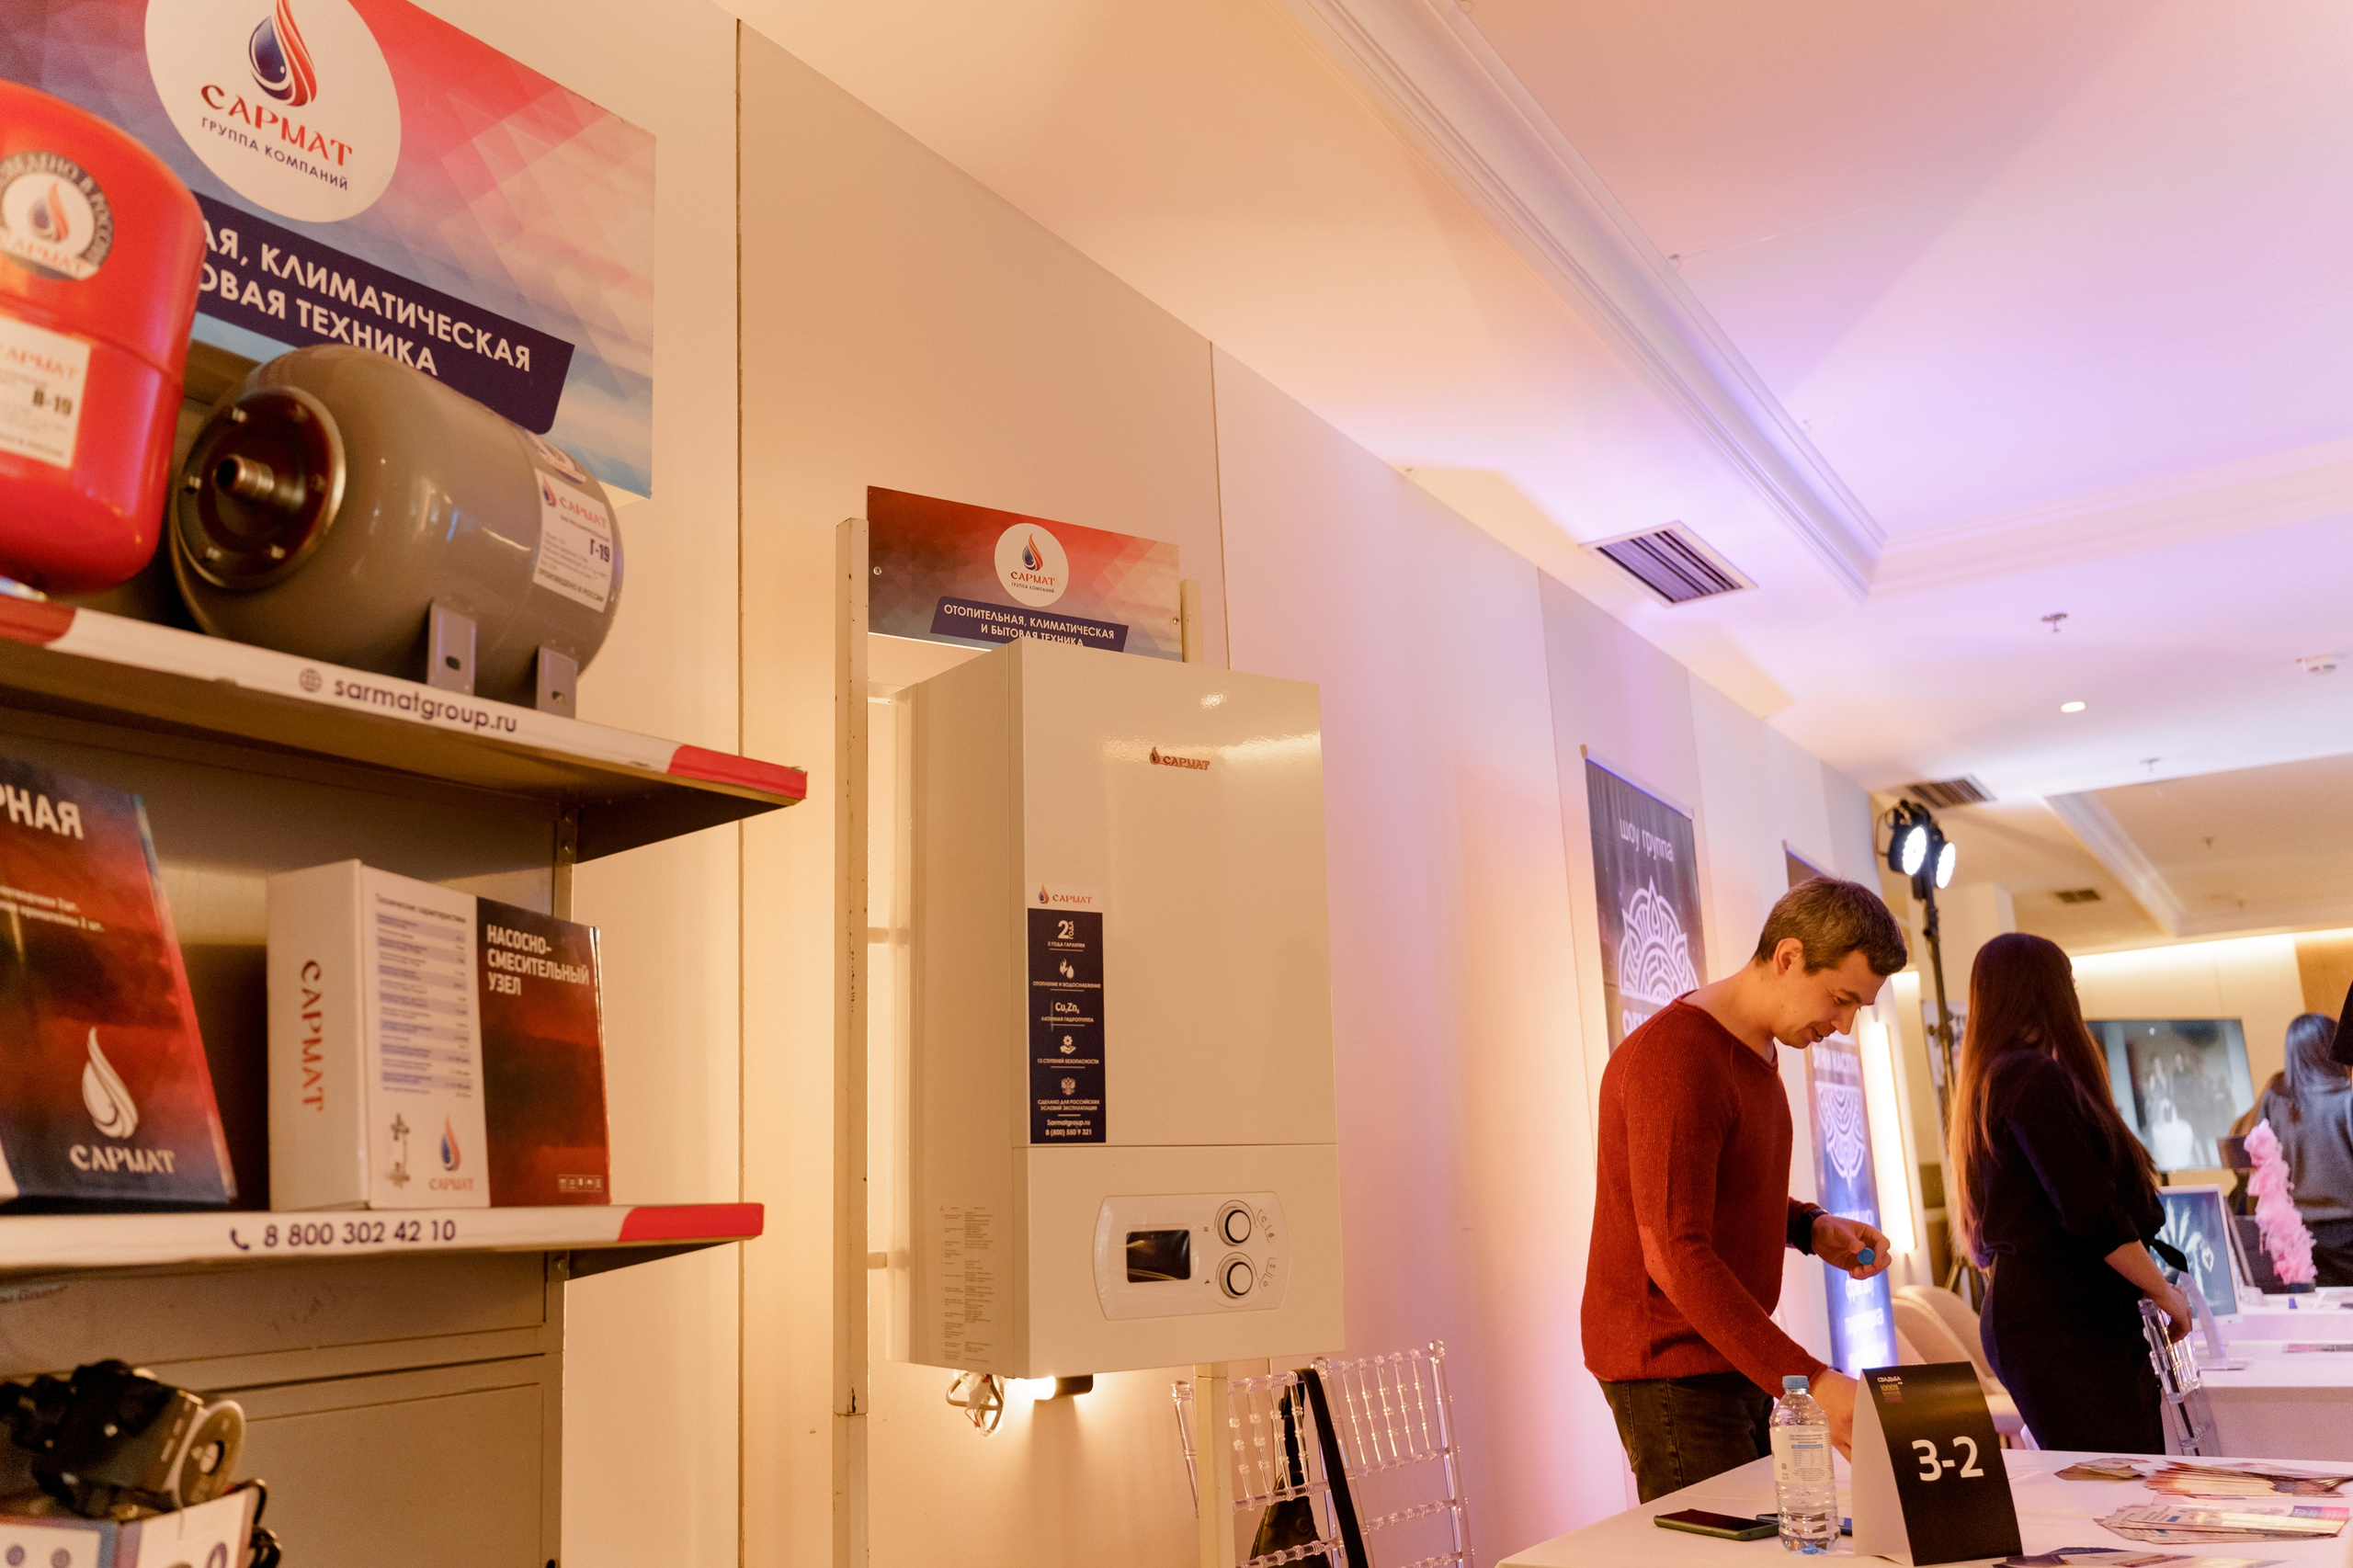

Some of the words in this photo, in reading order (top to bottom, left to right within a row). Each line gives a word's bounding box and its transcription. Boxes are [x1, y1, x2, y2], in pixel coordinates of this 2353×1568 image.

[200, 85, 353, 166] САРМАТ
[201, 117, 258, 152] ГРУППА
[265, 144, 348, 191] КОМПАНИЙ
[260, 243, 530, 372] КЛИМАТИЧЕСКАЯ
[296, 299, 439, 377] ТЕХНИКА
[559, 496, 608, 529] САРМАТ
[590, 539, 610, 563] Г-19
[1010, 571, 1055, 586] САРМАТ
[1029, 585, 1055, 594] КОМПАНИЙ
[943, 604, 1028, 627] ОТОПИТЕЛЬНАЯ,
[1029, 618, 1115, 640] КЛИМАТИЧЕСКАЯ
[981, 624, 988, 633] И
[991, 625, 1038, 641] БЫТОВАЯ
[1040, 631, 1084, 647] ТЕХНИКА
[335, 679, 517, 733] sarmatgroup.ru
[1163, 756, 1211, 770] САРМАТ
[1620, 818, 1640, 853] шоу
[1642, 829, 1674, 862] группа
[1052, 893, 1092, 904] САРМАТ
[487, 924, 552, 955] НАСОСНО-
[1058, 920, 1069, 939] 2
[487, 948, 590, 985] СМЕСИТЕЛЬНЫЙ
[487, 971, 522, 995] УЗЕЛ
[301, 960, 324, 1112] САРМАТ
[69, 1143, 175, 1174] САРМАТ
[428, 1177, 474, 1191] САРМАТ
[264, 1223, 278, 1248] 8
[288, 1222, 335, 1246] 800
[342, 1221, 385, 1244] 302
[394, 1220, 421, 1242] 42
[431, 1220, 456, 1241] 10
[1911, 1436, 1984, 1482] 3-2
